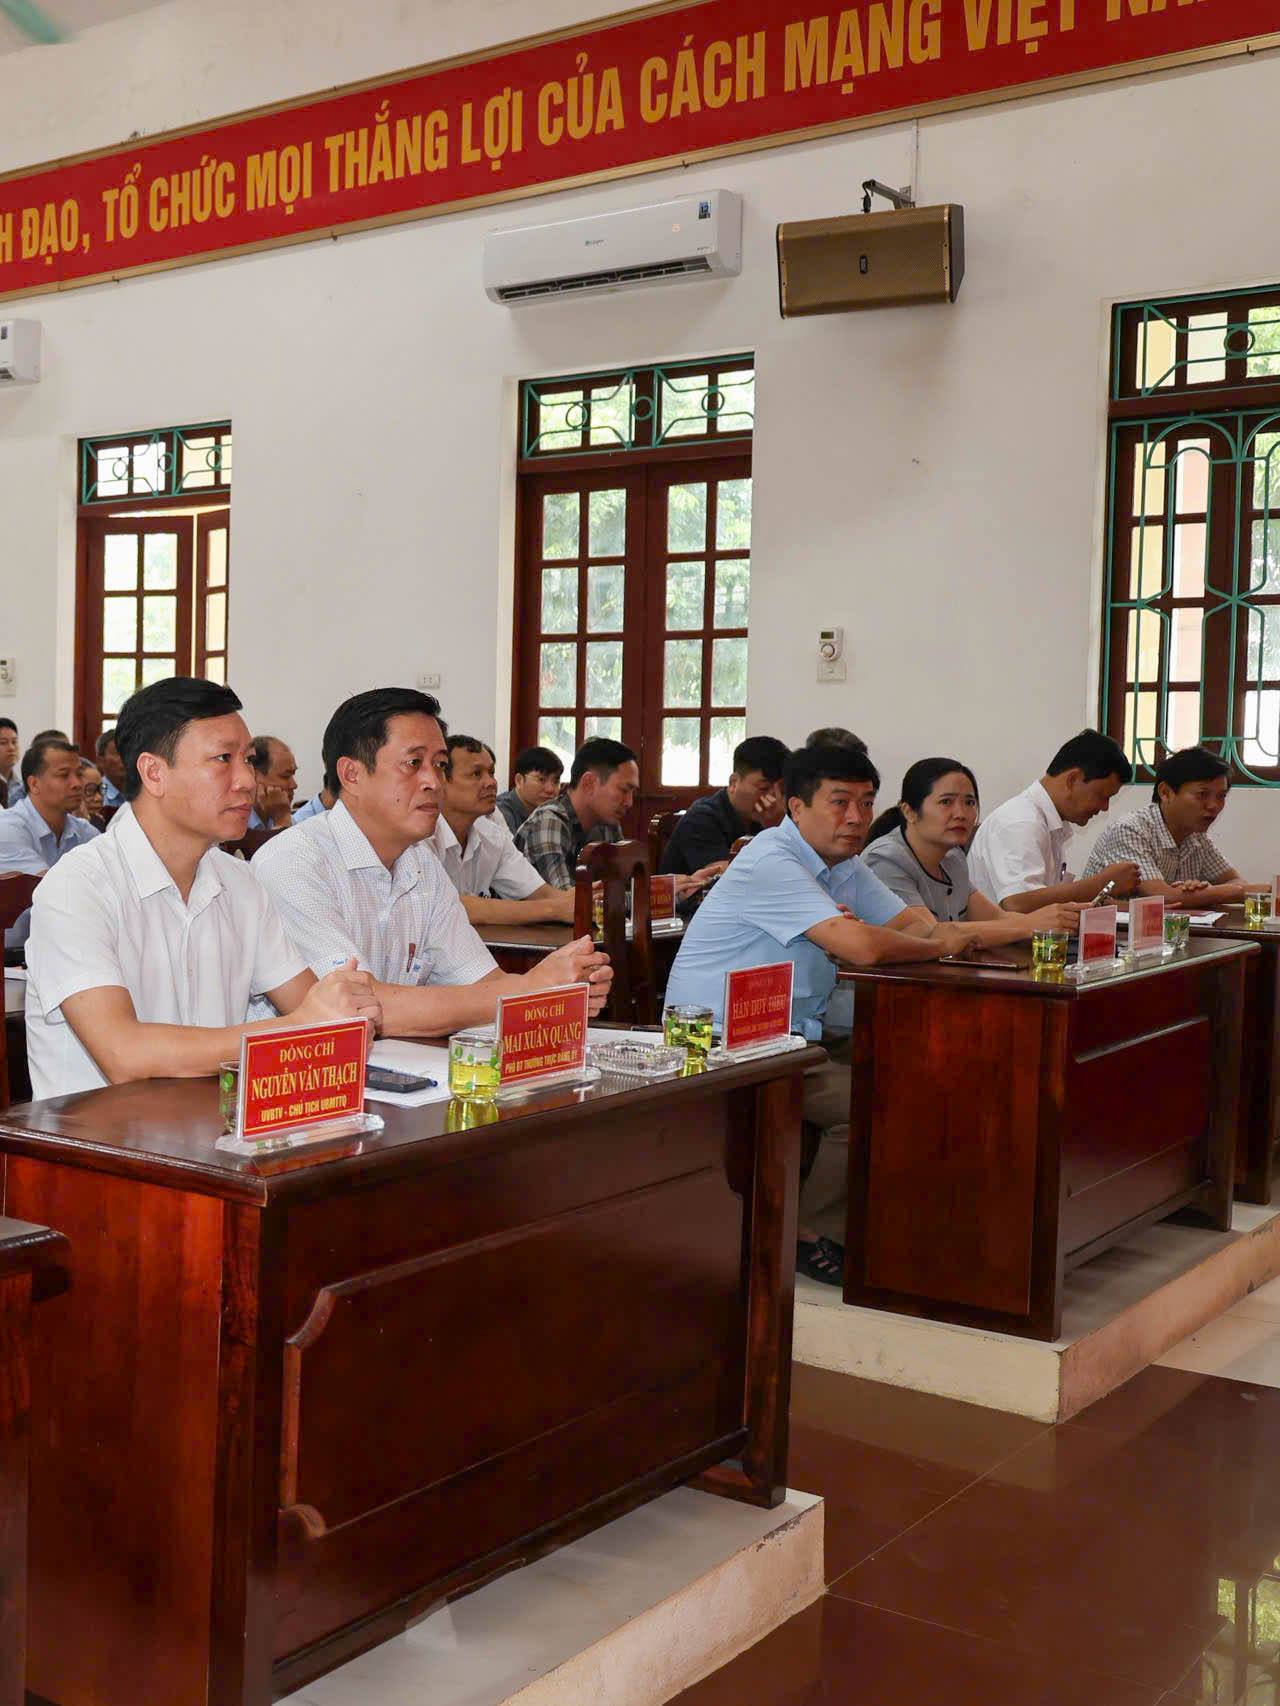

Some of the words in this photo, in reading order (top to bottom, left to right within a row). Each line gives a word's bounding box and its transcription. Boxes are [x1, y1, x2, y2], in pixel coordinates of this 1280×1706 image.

[21, 199, 90, 264] ĐẠO,
[102, 162, 141, 242] TỔ
[149, 155, 235, 232] CHỨC
[246, 141, 312, 215] MỌI
[324, 99, 449, 193] THẮNG
[461, 86, 523, 171] LỢI
[538, 52, 625, 146] CỦA
[640, 34, 766, 124] CÁCH
[784, 0, 942, 95] MẠNG
[503, 1032, 522, 1055] MAI
[523, 1023, 549, 1051] XUÂN
[550, 1021, 582, 1048] QUANG
[251, 1067, 297, 1100] NGUYỄN
[299, 1064, 320, 1092] VĂN
[322, 1062, 357, 1090] THẠCH
[261, 1106, 283, 1122] UVBTV
[305, 1099, 320, 1116] TỊCH
